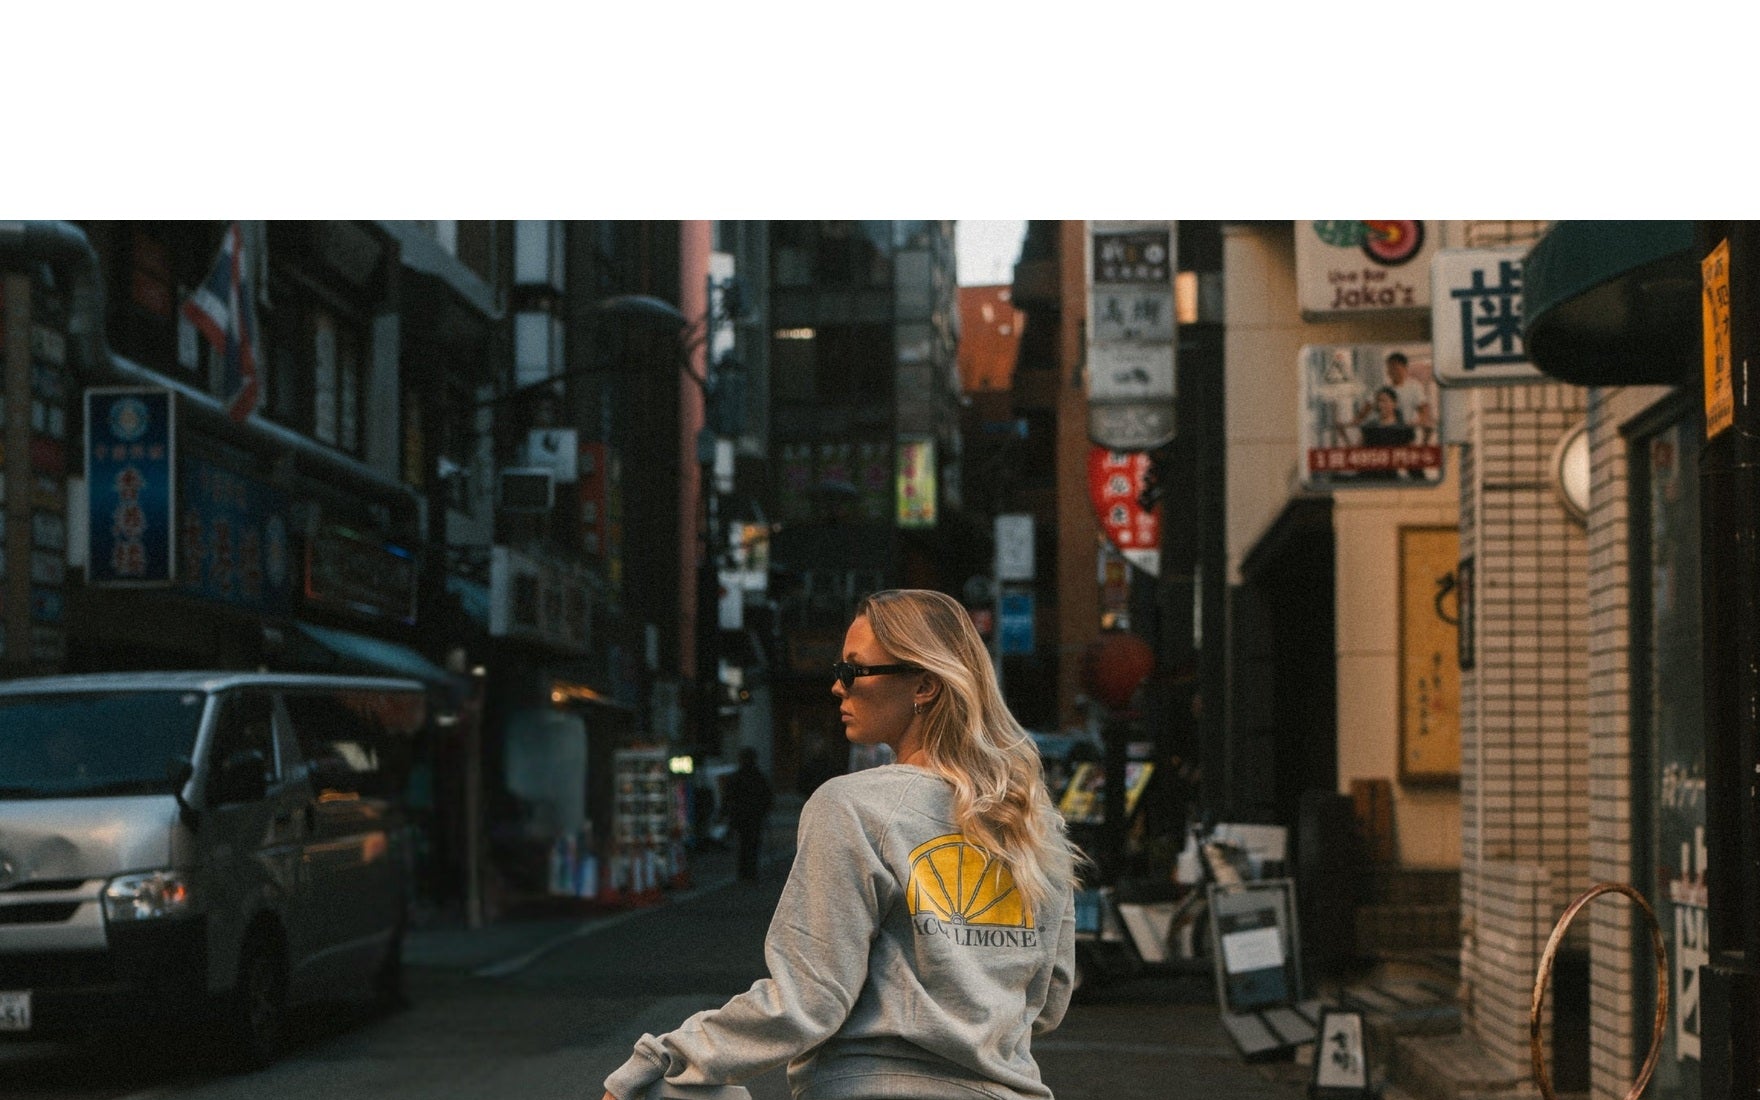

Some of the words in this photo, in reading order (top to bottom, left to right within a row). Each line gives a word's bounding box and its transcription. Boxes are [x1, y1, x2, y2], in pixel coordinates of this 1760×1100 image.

[1332, 282, 1415, 308] Jaka'z
[1451, 261, 1524, 371] 歯
[954, 928, 1037, 948] LIMONE
